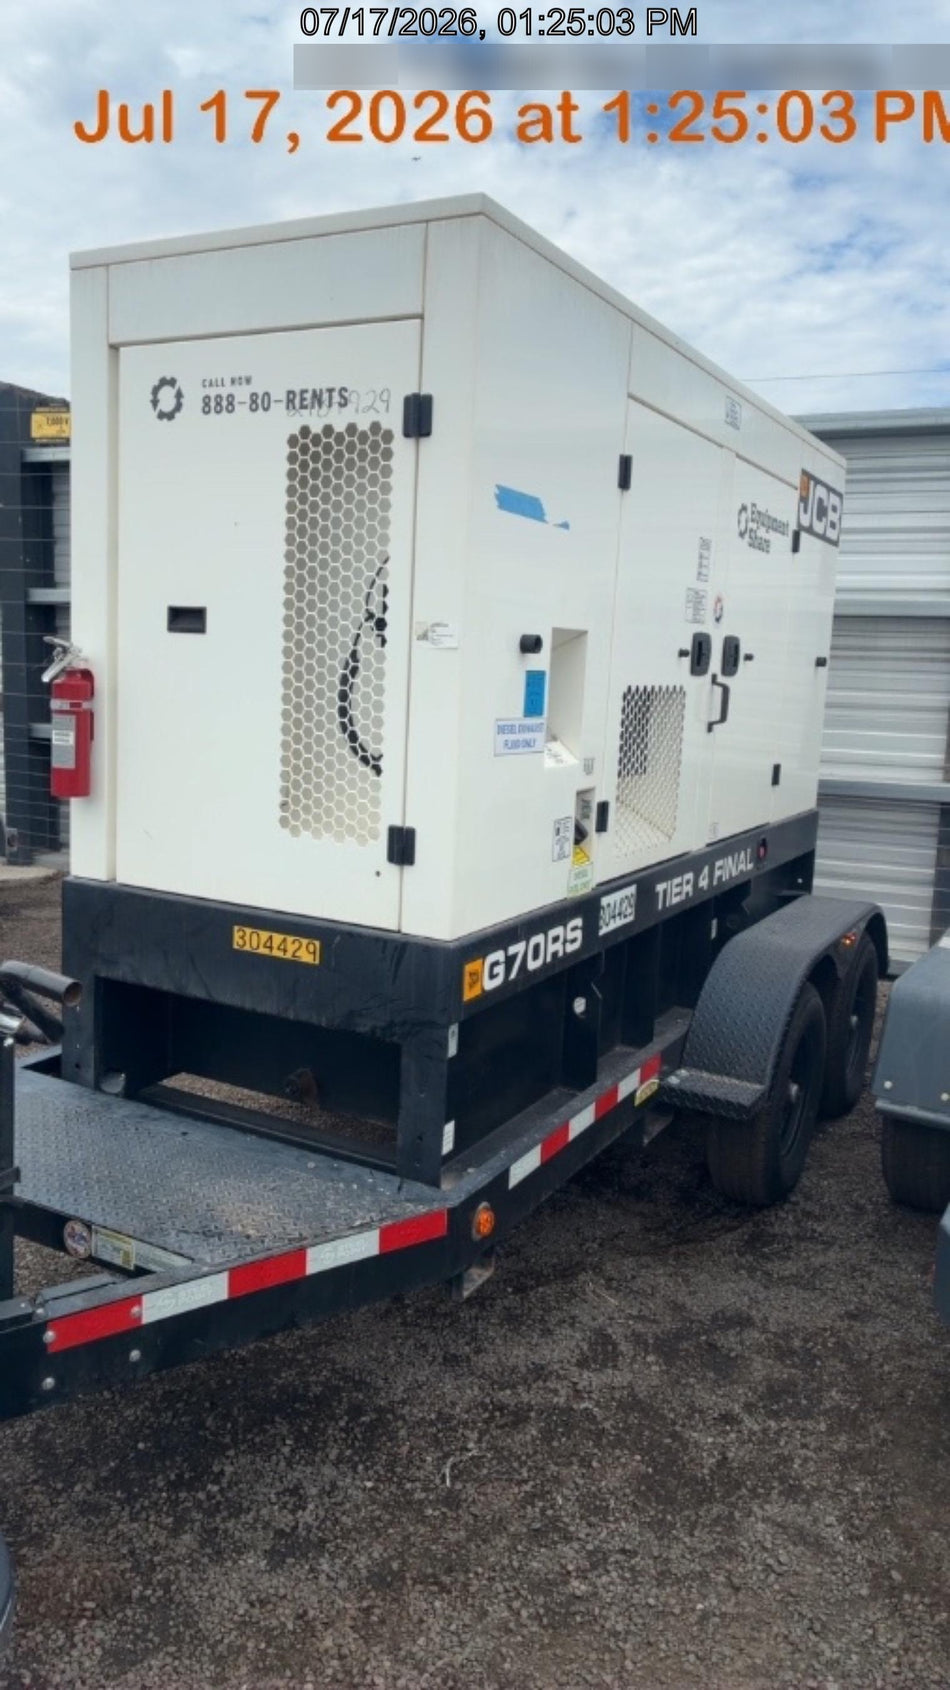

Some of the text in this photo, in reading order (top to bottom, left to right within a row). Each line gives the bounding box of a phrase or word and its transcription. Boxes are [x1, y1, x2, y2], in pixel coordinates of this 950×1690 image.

[202, 375, 252, 388] CALL NOW
[201, 386, 349, 415] 888-80-RENTS
[751, 502, 789, 537] Equipment
[799, 479, 841, 542] JCB
[748, 527, 770, 554] Share
[655, 848, 754, 910] TIER 4 FINAL
[236, 928, 317, 962] 304429
[483, 917, 583, 991] G70RS
